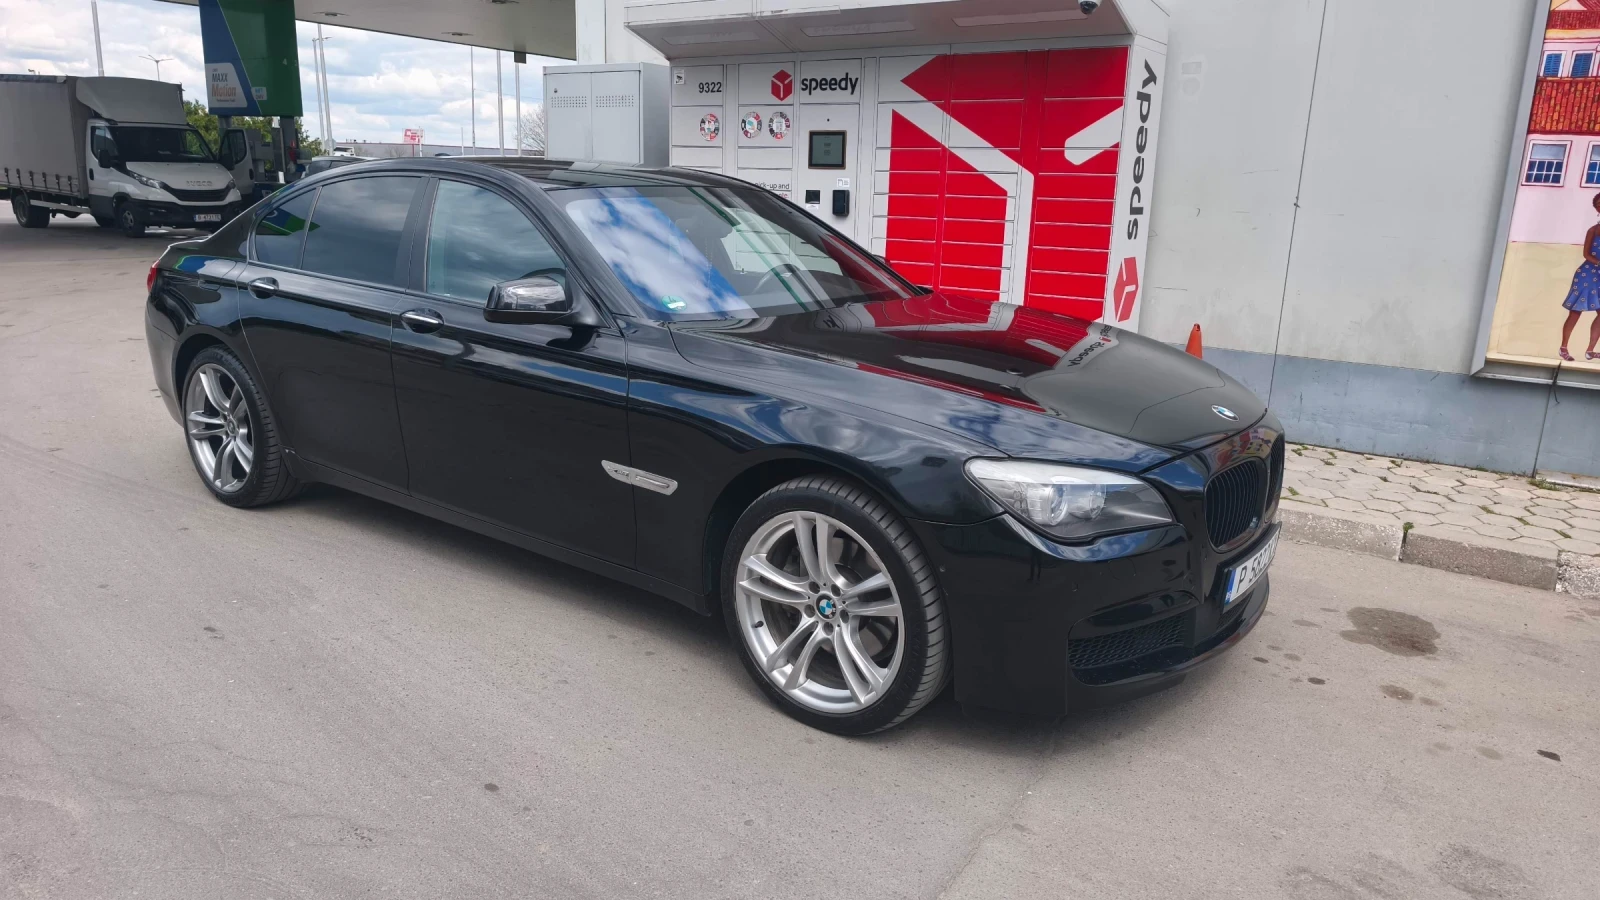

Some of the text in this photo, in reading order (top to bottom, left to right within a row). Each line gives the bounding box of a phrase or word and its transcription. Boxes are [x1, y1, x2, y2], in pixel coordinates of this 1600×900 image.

[211, 73, 228, 82] MAXX
[801, 72, 859, 96] speedy
[211, 83, 237, 98] Motion
[698, 81, 722, 94] 9322
[1127, 58, 1158, 240] speedy
[1237, 565, 1247, 593] P
